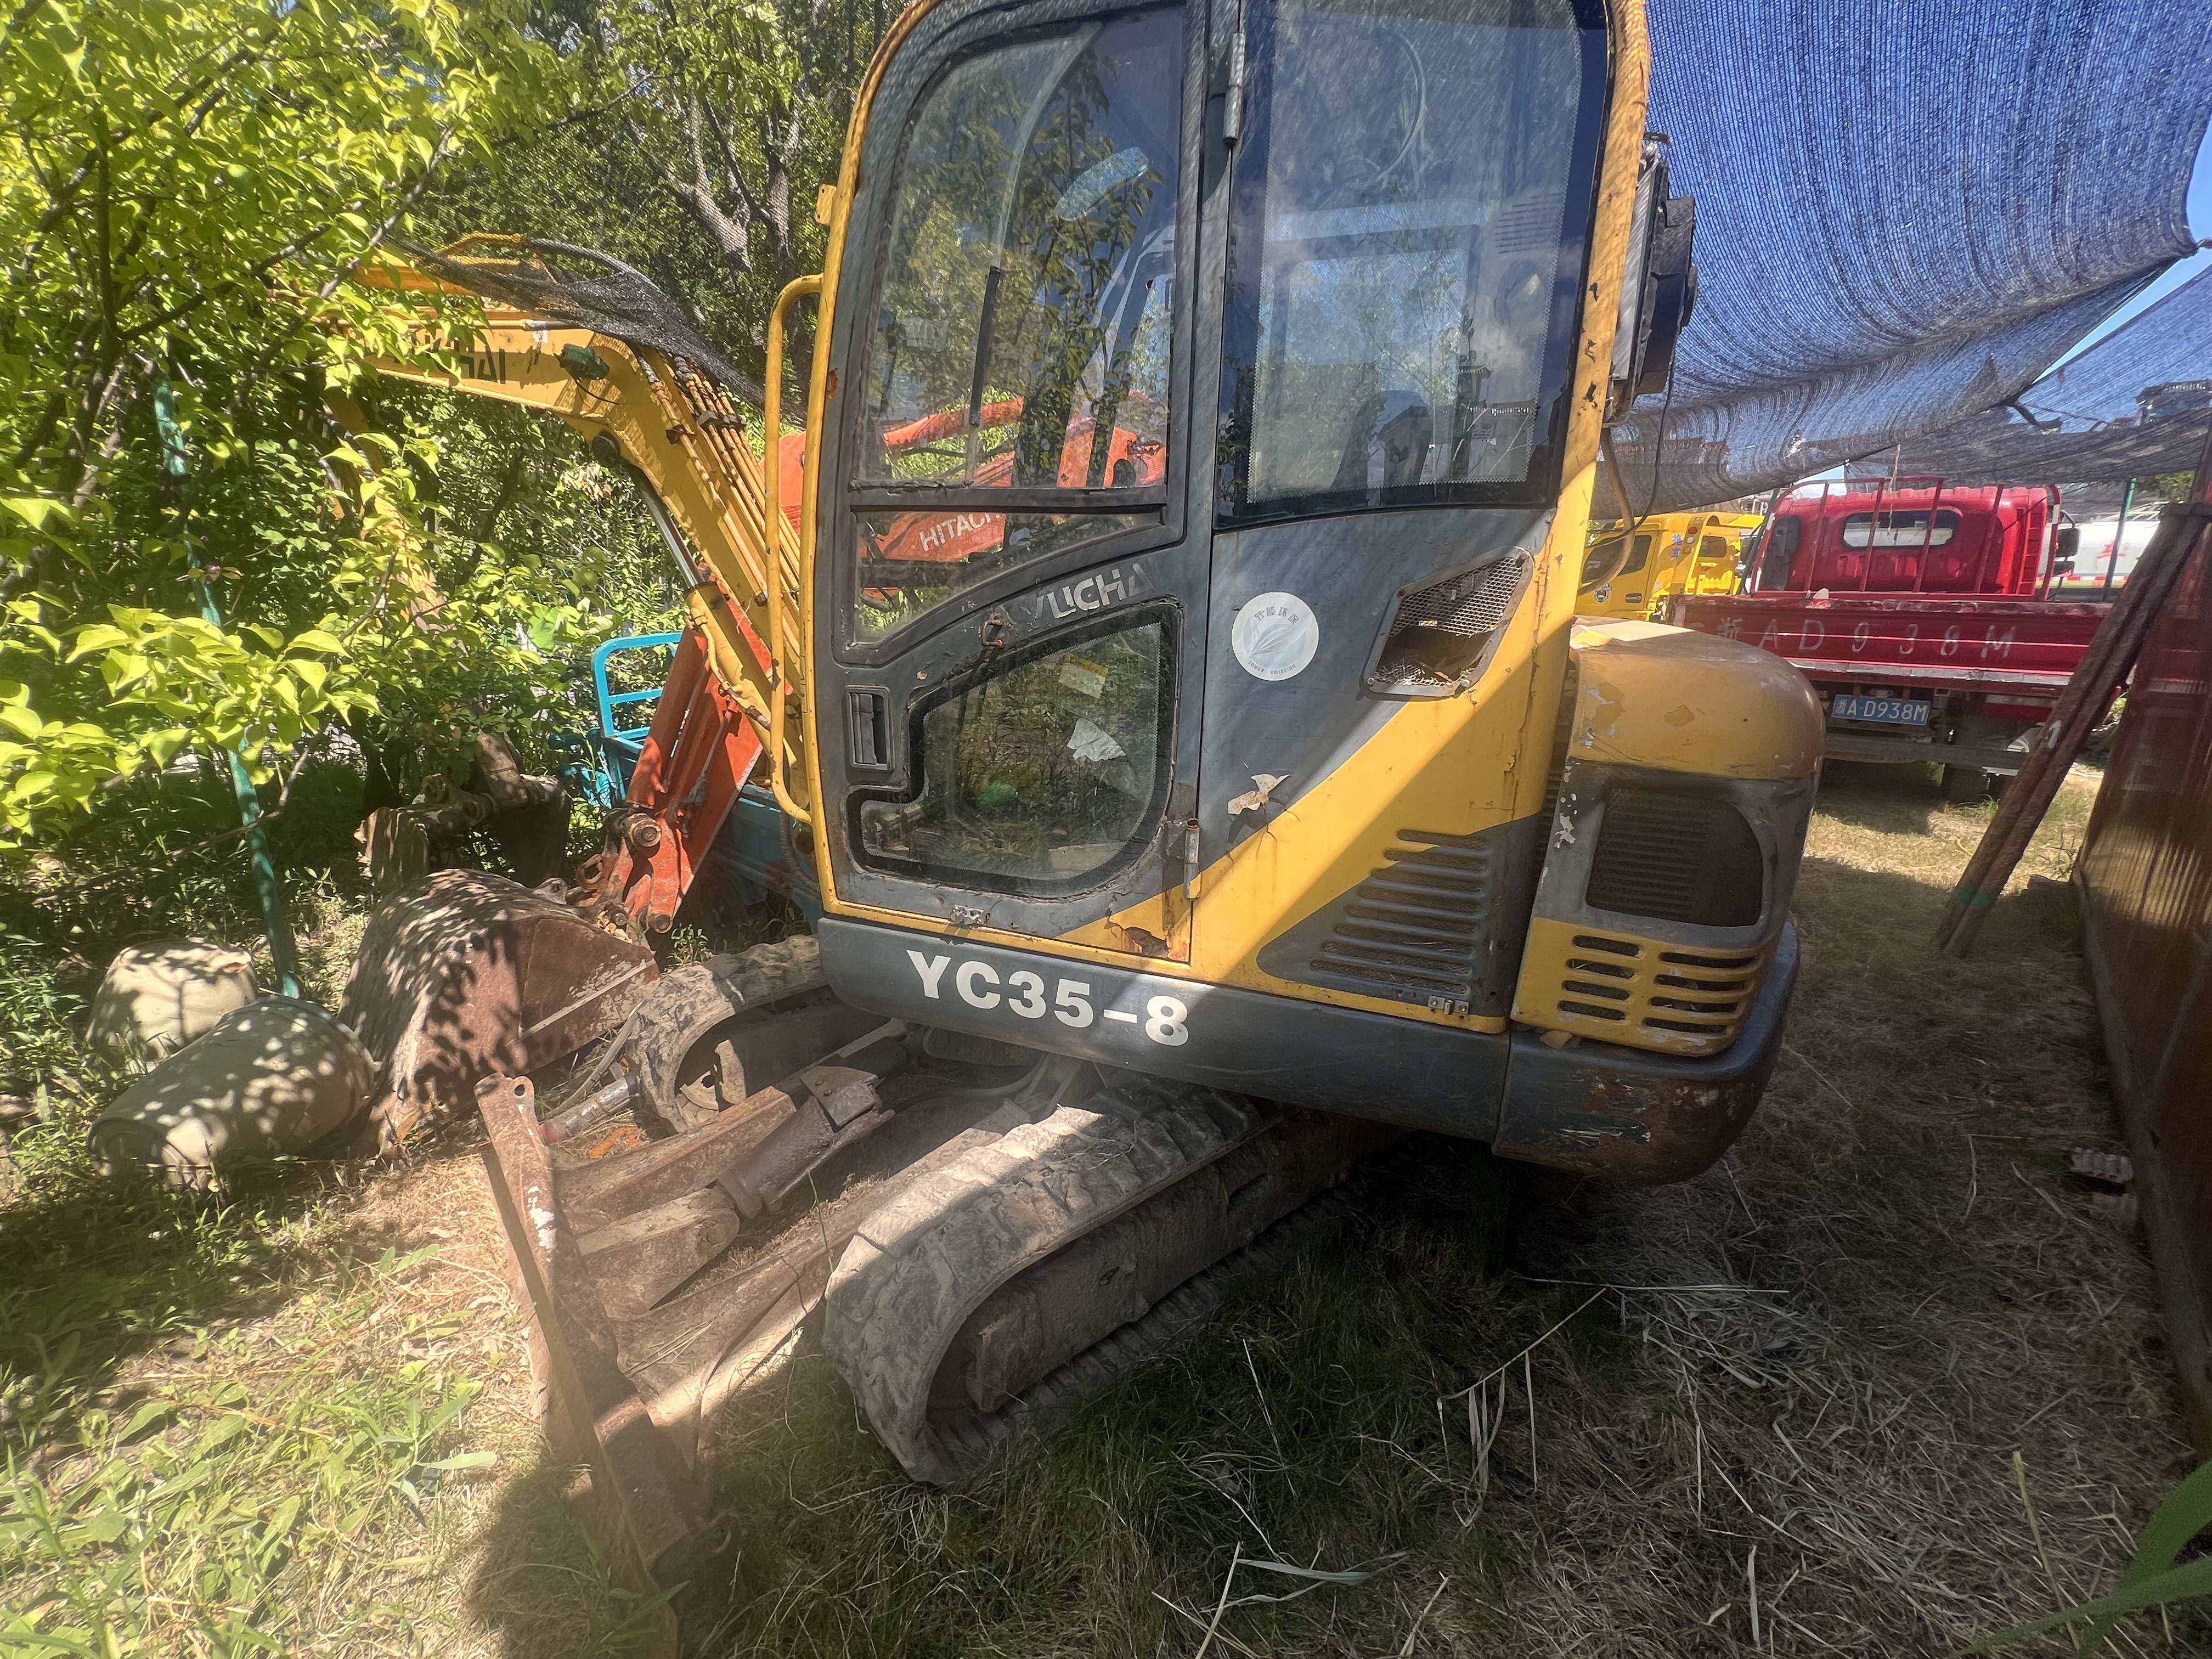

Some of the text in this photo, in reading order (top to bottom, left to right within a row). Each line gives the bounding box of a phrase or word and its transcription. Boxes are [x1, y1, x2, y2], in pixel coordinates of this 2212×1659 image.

[919, 513, 1000, 552] HITAC
[1254, 606, 1299, 625] 节能环保
[1248, 661, 1296, 675] LOWER EMISSION
[906, 949, 1189, 1047] YC35-8
